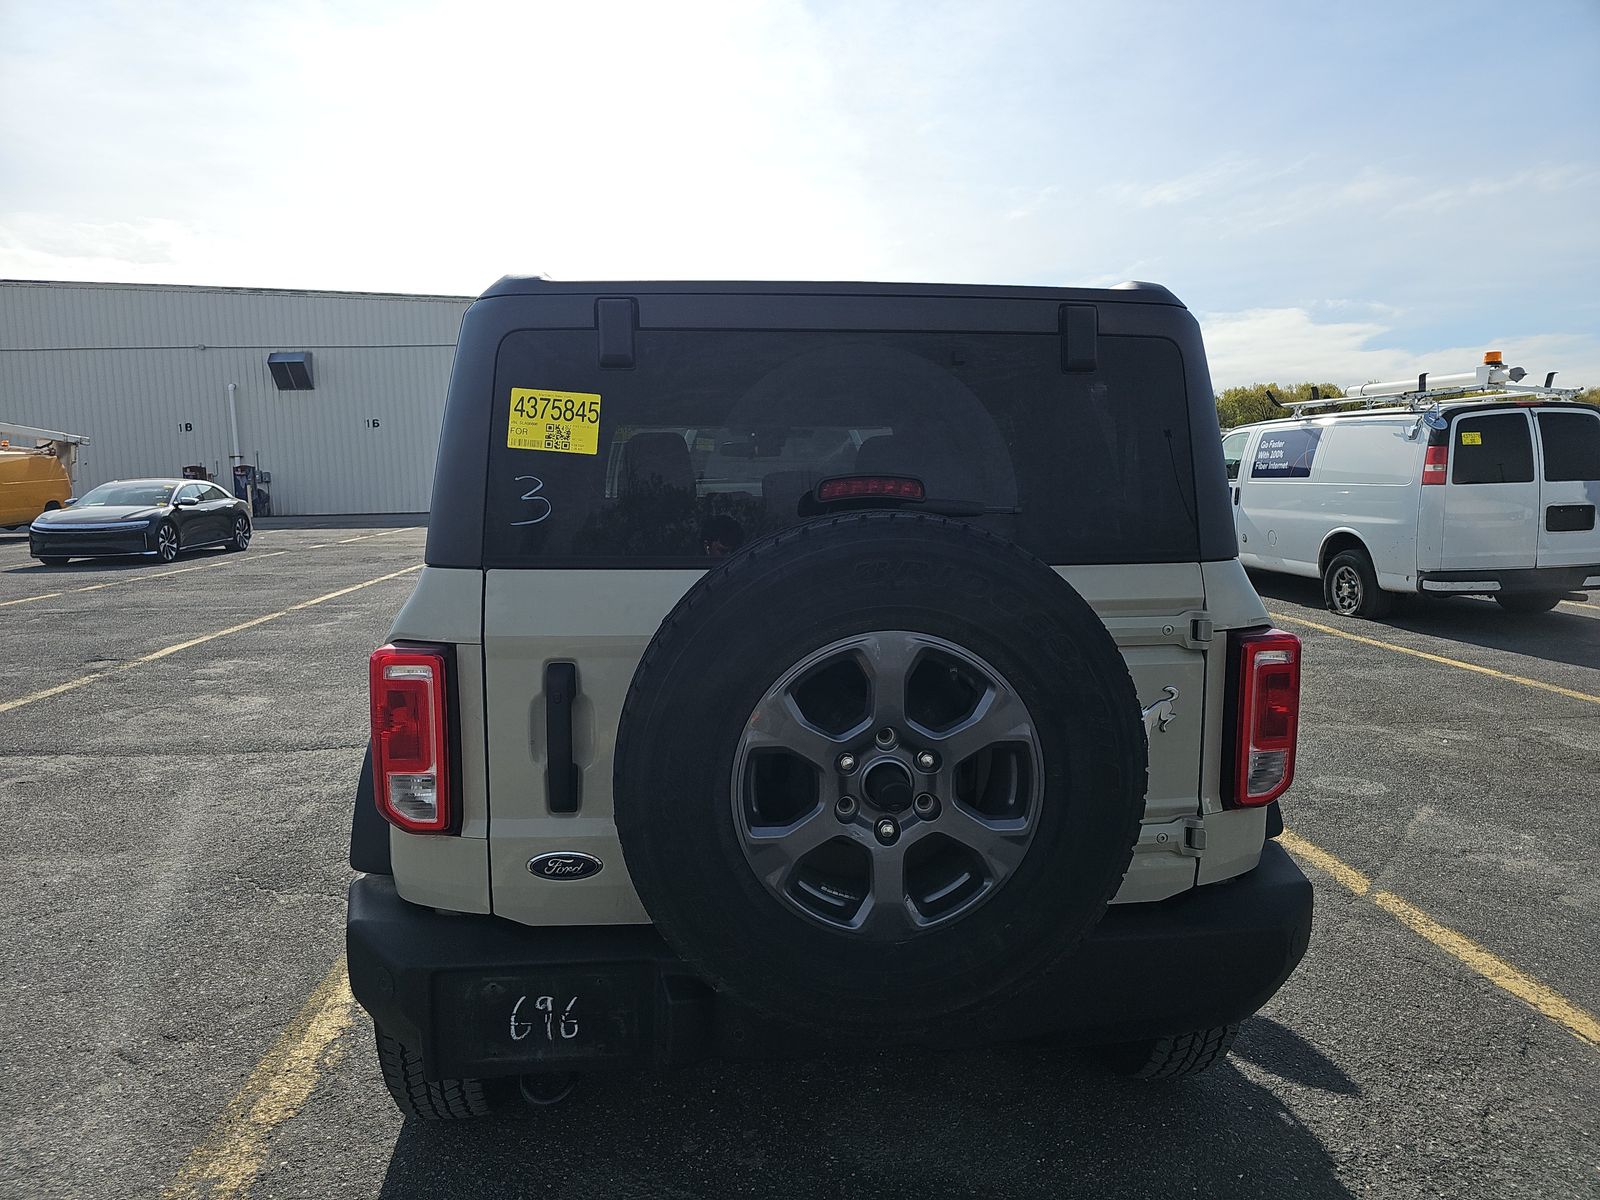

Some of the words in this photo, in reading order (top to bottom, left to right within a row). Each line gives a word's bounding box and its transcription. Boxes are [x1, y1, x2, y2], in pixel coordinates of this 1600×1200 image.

[514, 396, 600, 424] 4375845
[510, 426, 529, 436] FOR
[1260, 440, 1269, 449] Go
[1269, 439, 1285, 448] Faster
[1258, 450, 1270, 459] With
[1270, 450, 1285, 459] 100%
[1255, 461, 1268, 470] Fiber
[1268, 461, 1289, 470] Internet
[510, 475, 552, 526] 3
[544, 858, 586, 875] Ford
[510, 995, 579, 1041] 696
